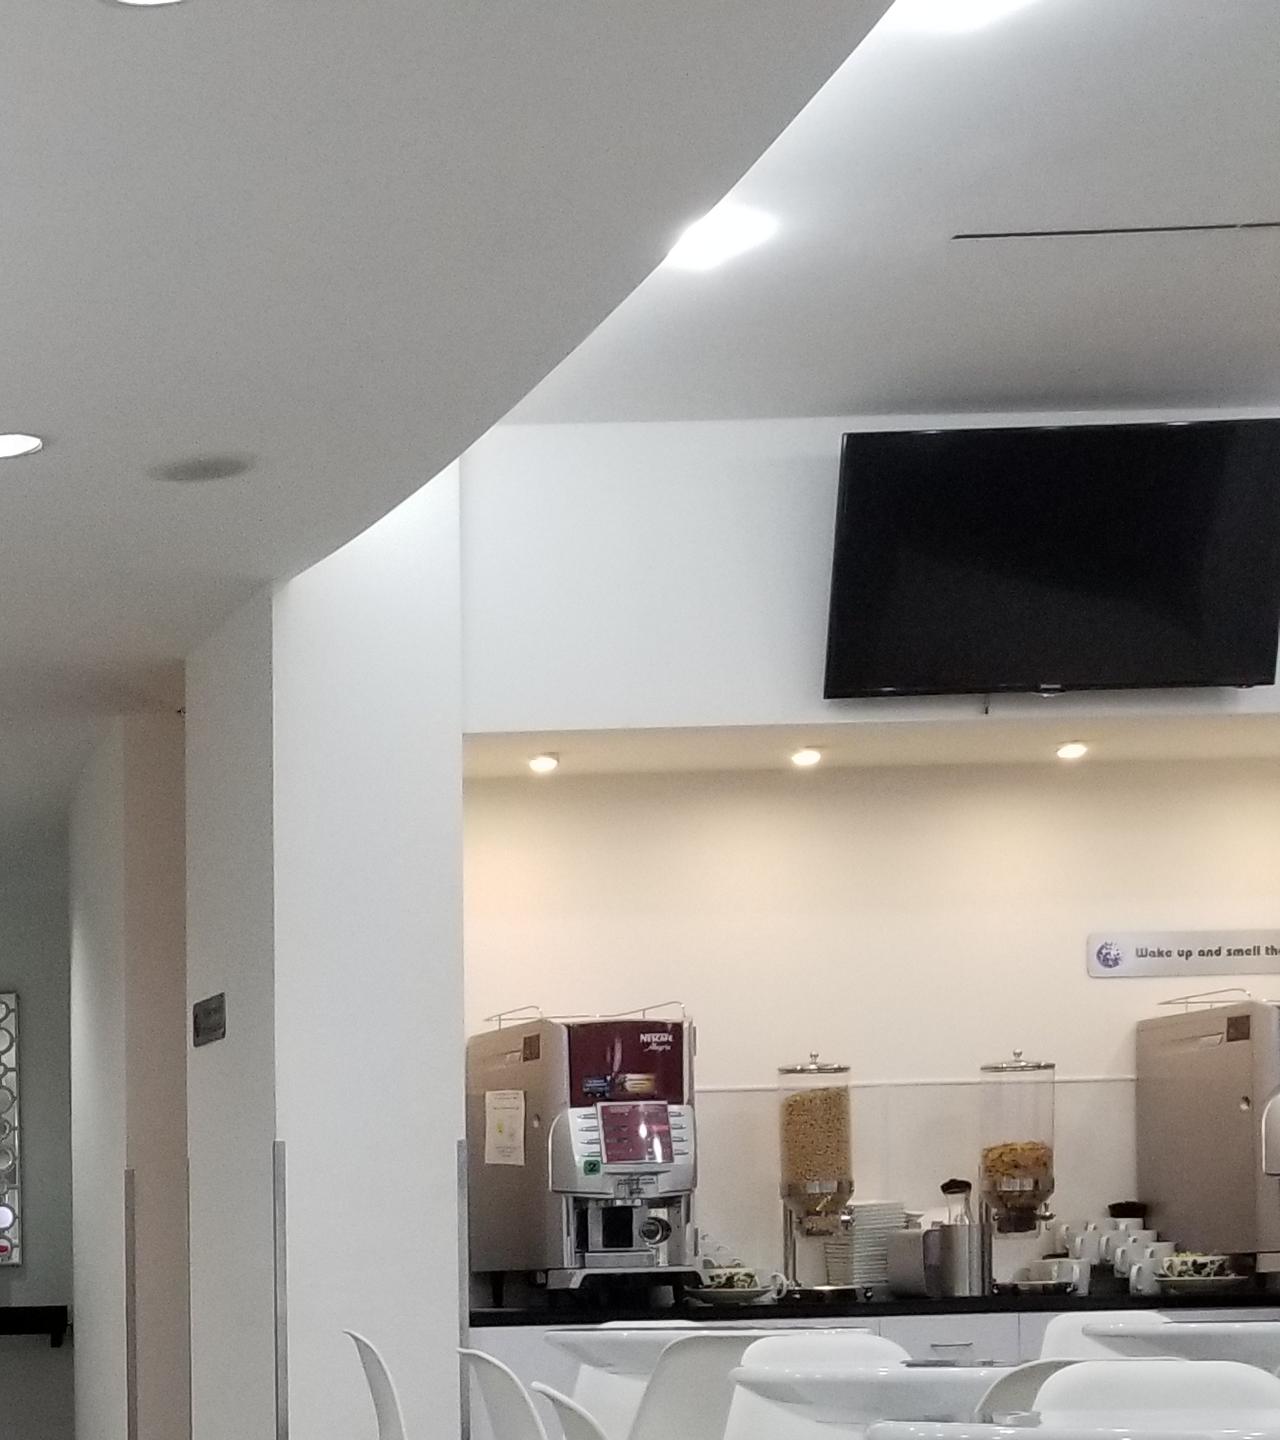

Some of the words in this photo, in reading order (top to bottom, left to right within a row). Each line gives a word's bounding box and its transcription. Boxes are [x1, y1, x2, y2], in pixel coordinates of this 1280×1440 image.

[1135, 947, 1172, 959] Wake
[1177, 948, 1193, 961] up
[1197, 946, 1222, 958] and
[1226, 945, 1261, 957] smell
